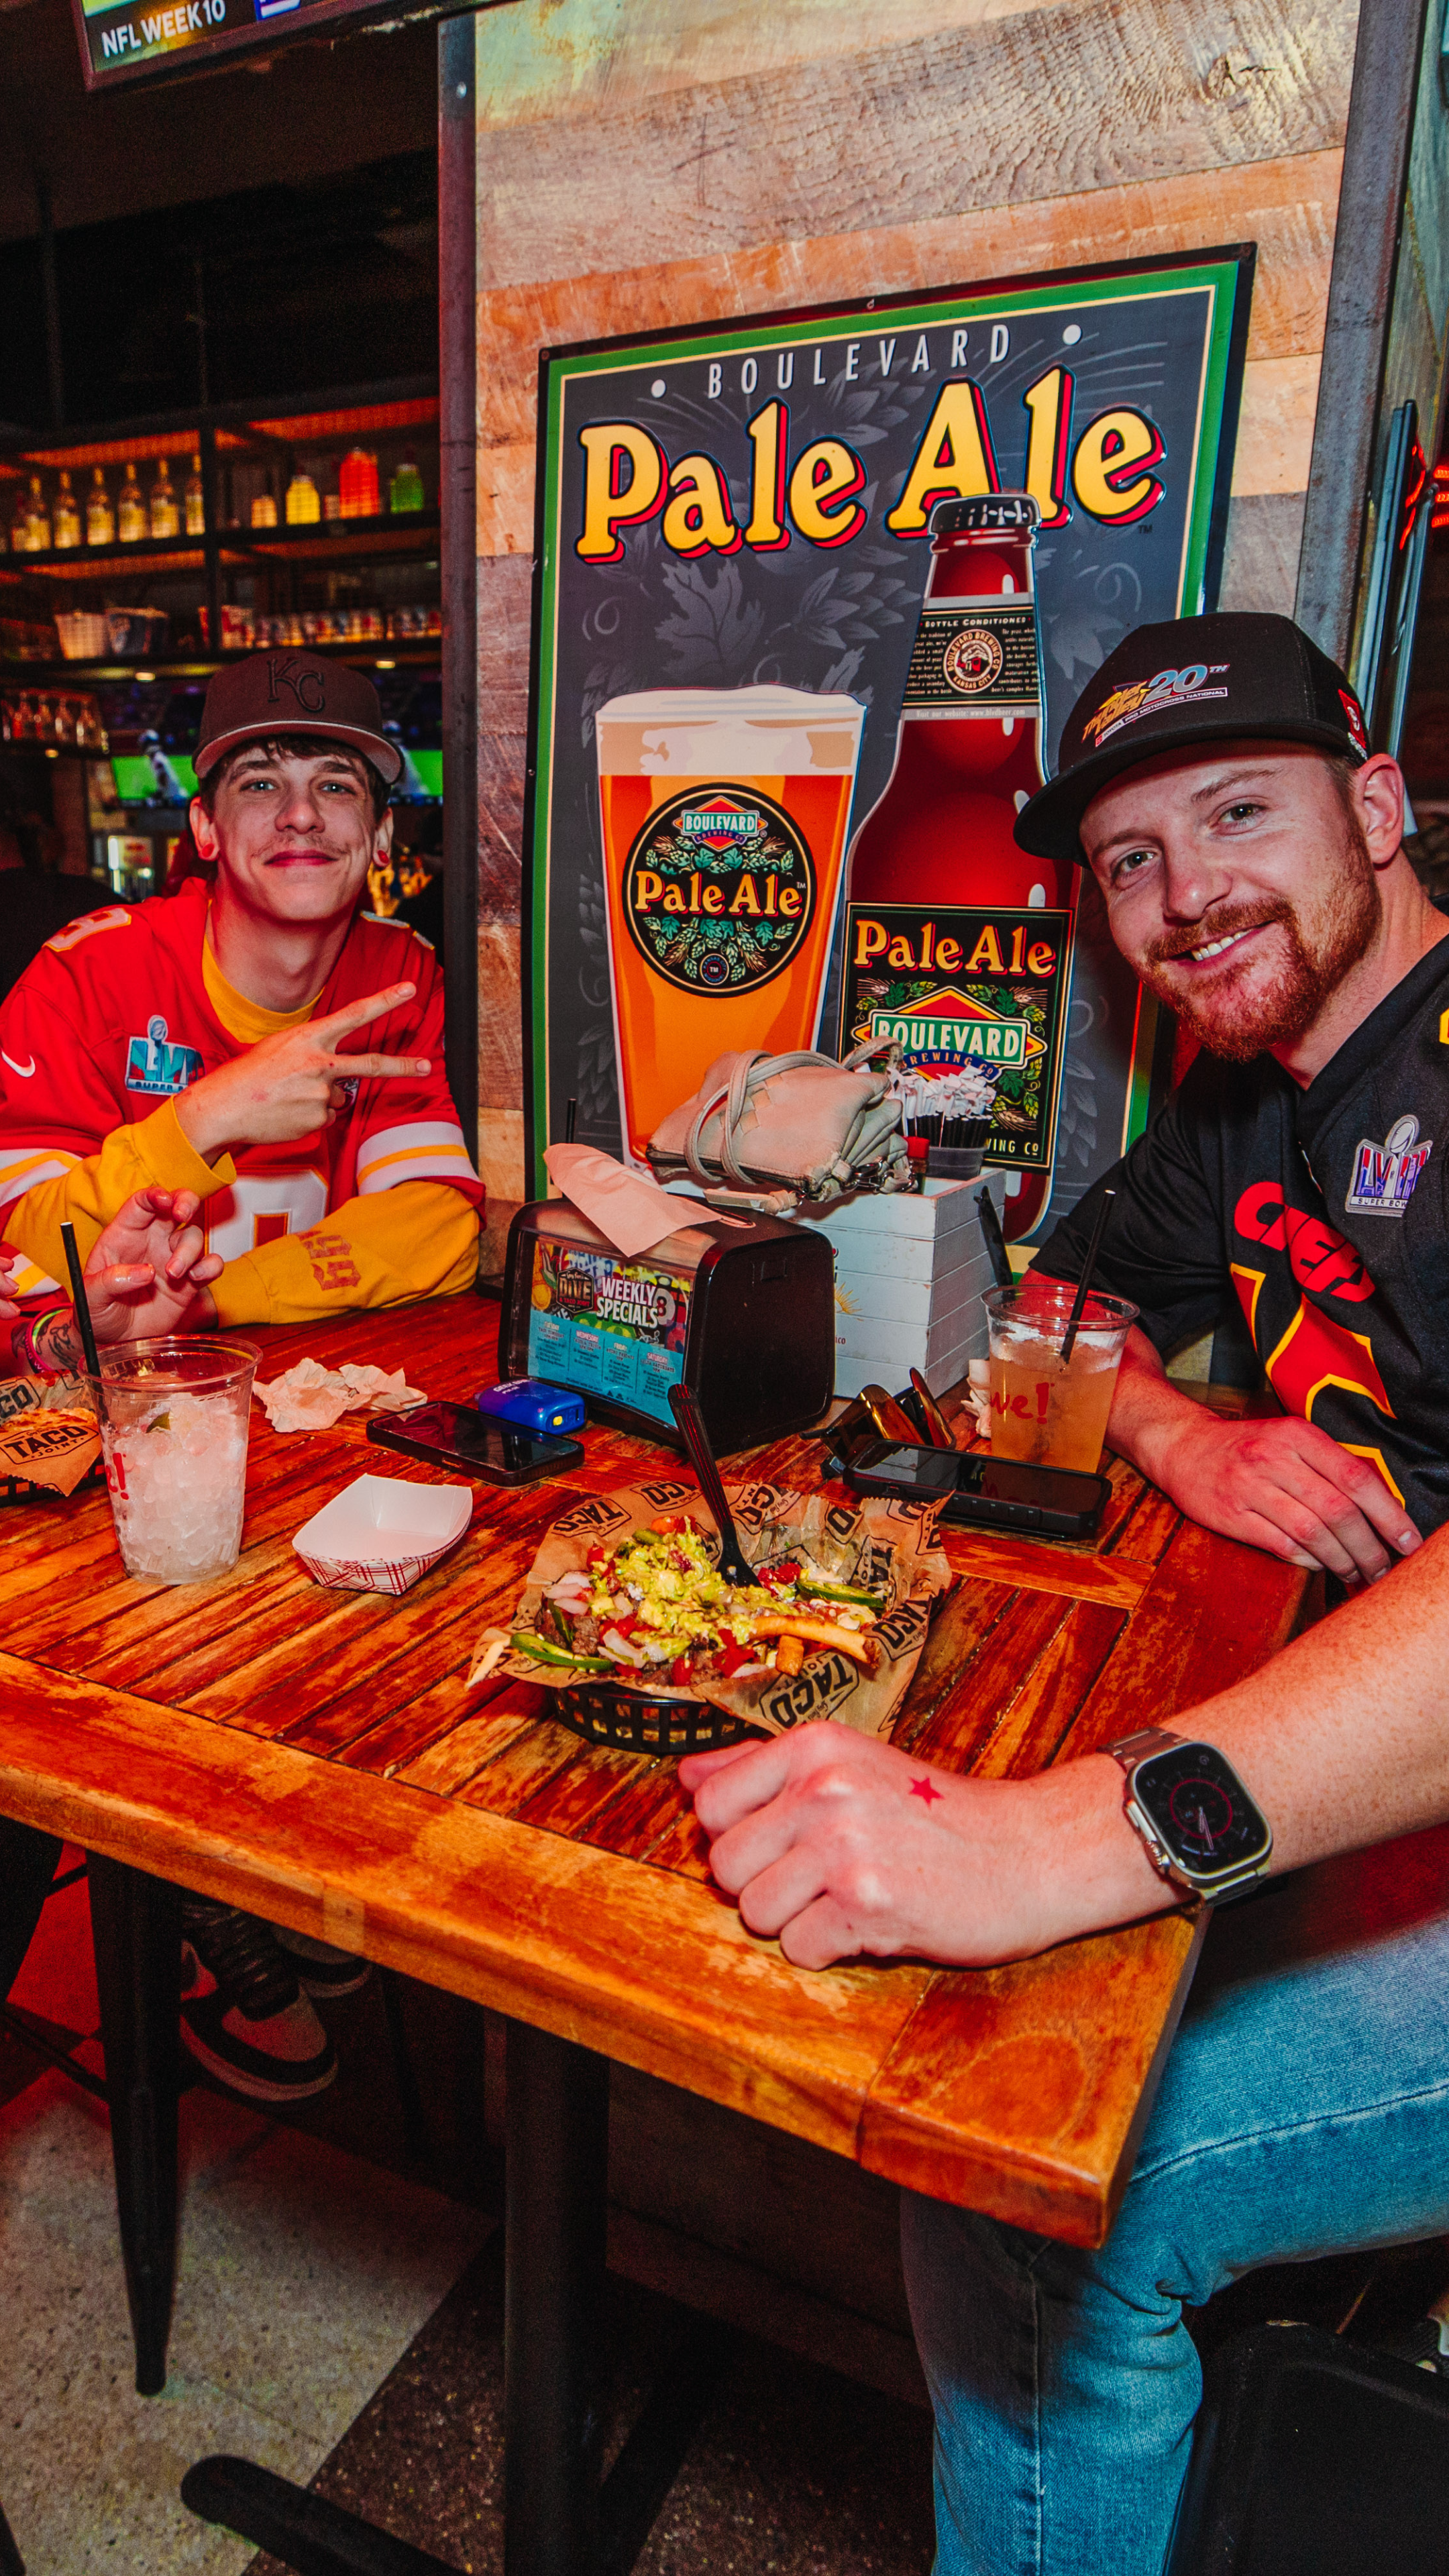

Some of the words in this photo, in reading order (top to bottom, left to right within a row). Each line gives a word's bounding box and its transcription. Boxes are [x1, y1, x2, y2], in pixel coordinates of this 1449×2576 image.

[101, 23, 142, 58] NFL
[140, 1, 203, 44] WEEK
[202, 0, 225, 25] 10
[708, 324, 1011, 399] BOULEVARD
[575, 396, 868, 564] Pale
[885, 364, 1168, 539] Ale
[925, 620, 959, 628] BOTTLE
[963, 617, 1026, 626] CONDITIONED
[947, 632, 973, 672] BOULEVARD
[975, 631, 1000, 657] BREWING
[267, 658, 326, 713] KC
[953, 676, 977, 688] KANSAS
[979, 674, 991, 686] CITY
[1125, 712, 1138, 722] PRO
[1139, 696, 1185, 714] MOTOCROSS
[1186, 690, 1224, 699] NATIONAL
[686, 815, 755, 831] BOULEVARD
[635, 871, 725, 916] Pale
[729, 873, 803, 918] Ale
[854, 920, 963, 974] Pale
[965, 925, 1056, 978] Ale
[135, 1081, 173, 1091] SUPER
[1358, 1198, 1385, 1206] SUPER
[1389, 1199, 1407, 1208] BOW
[559, 1277, 591, 1300] DIVE
[602, 1277, 656, 1306] WEEKLY
[596, 1297, 658, 1329] SPECIALS
[990, 1382, 1050, 1424] ve!
[3, 1426, 89, 1458] TACO
[38, 1439, 78, 1456] JOINT
[553, 1501, 625, 1532] TACO
[770, 1655, 853, 1729] TACO
